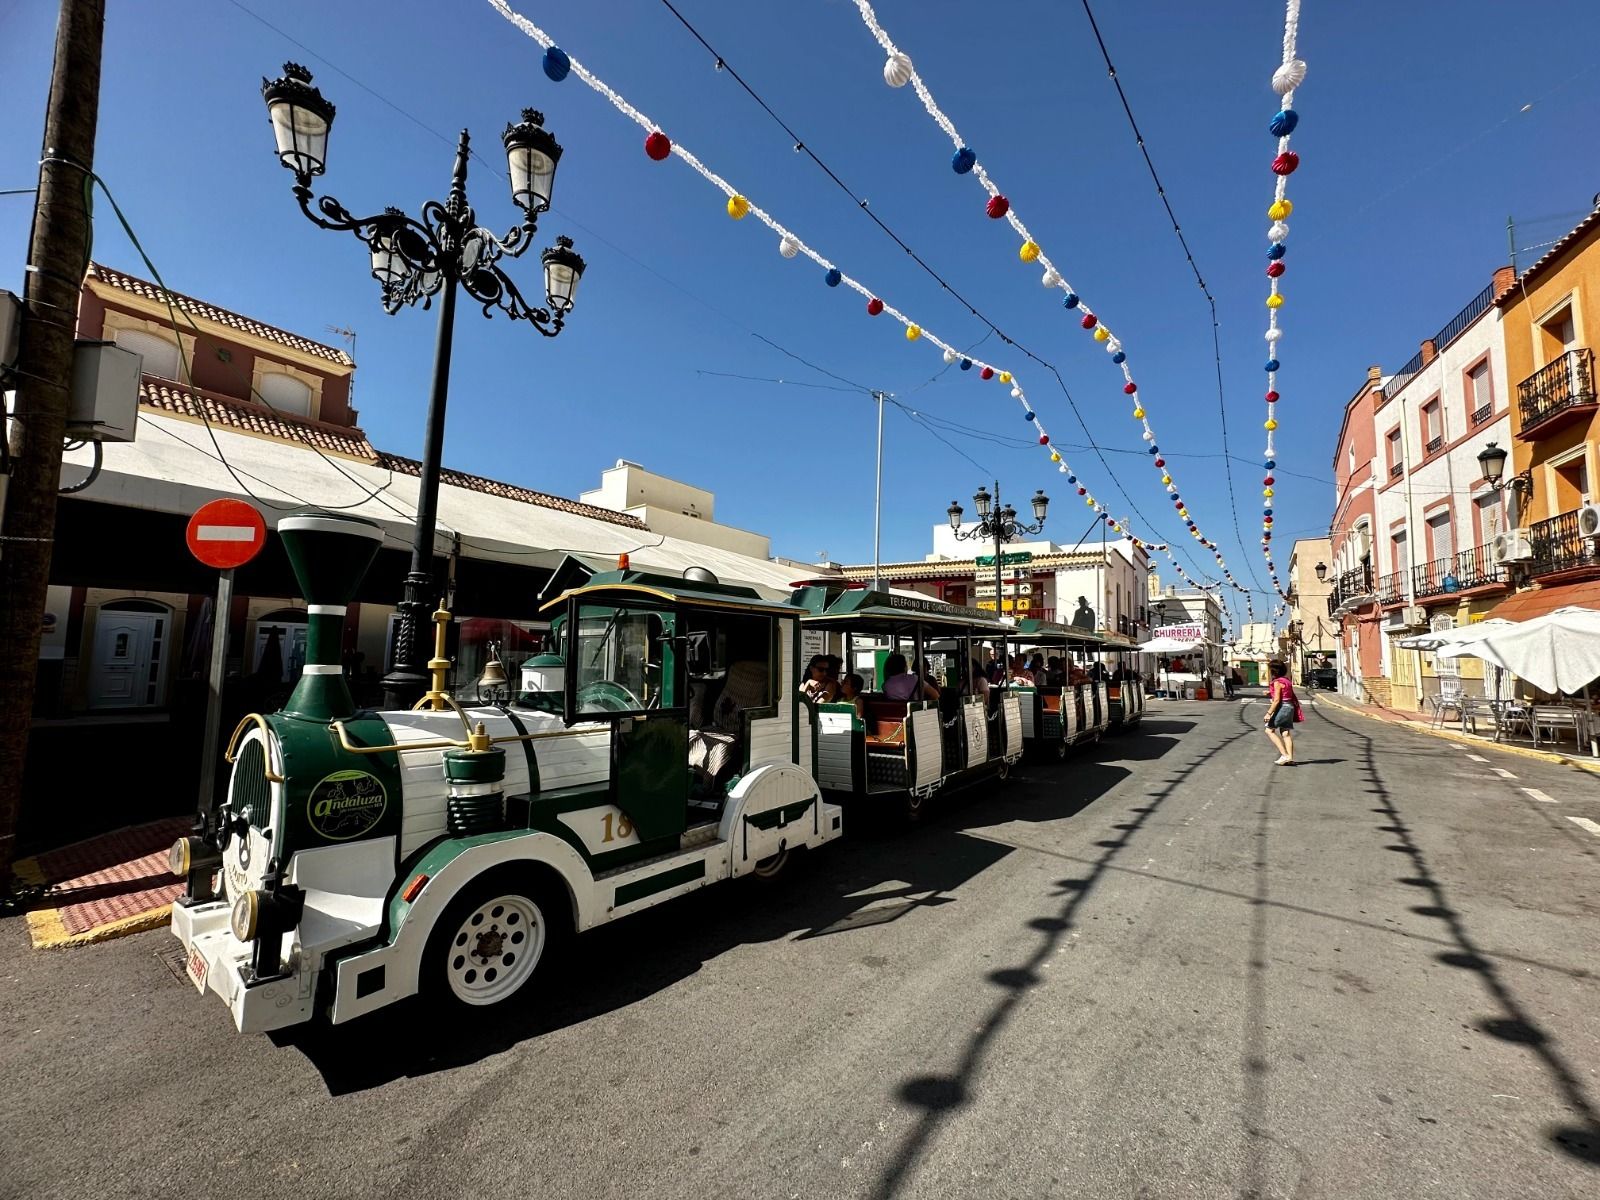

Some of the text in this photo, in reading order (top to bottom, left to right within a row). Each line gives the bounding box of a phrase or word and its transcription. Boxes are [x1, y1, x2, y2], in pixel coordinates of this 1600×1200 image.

[890, 596, 920, 608] TELÉFONO
[922, 600, 930, 610] DE
[601, 812, 632, 843] 18
